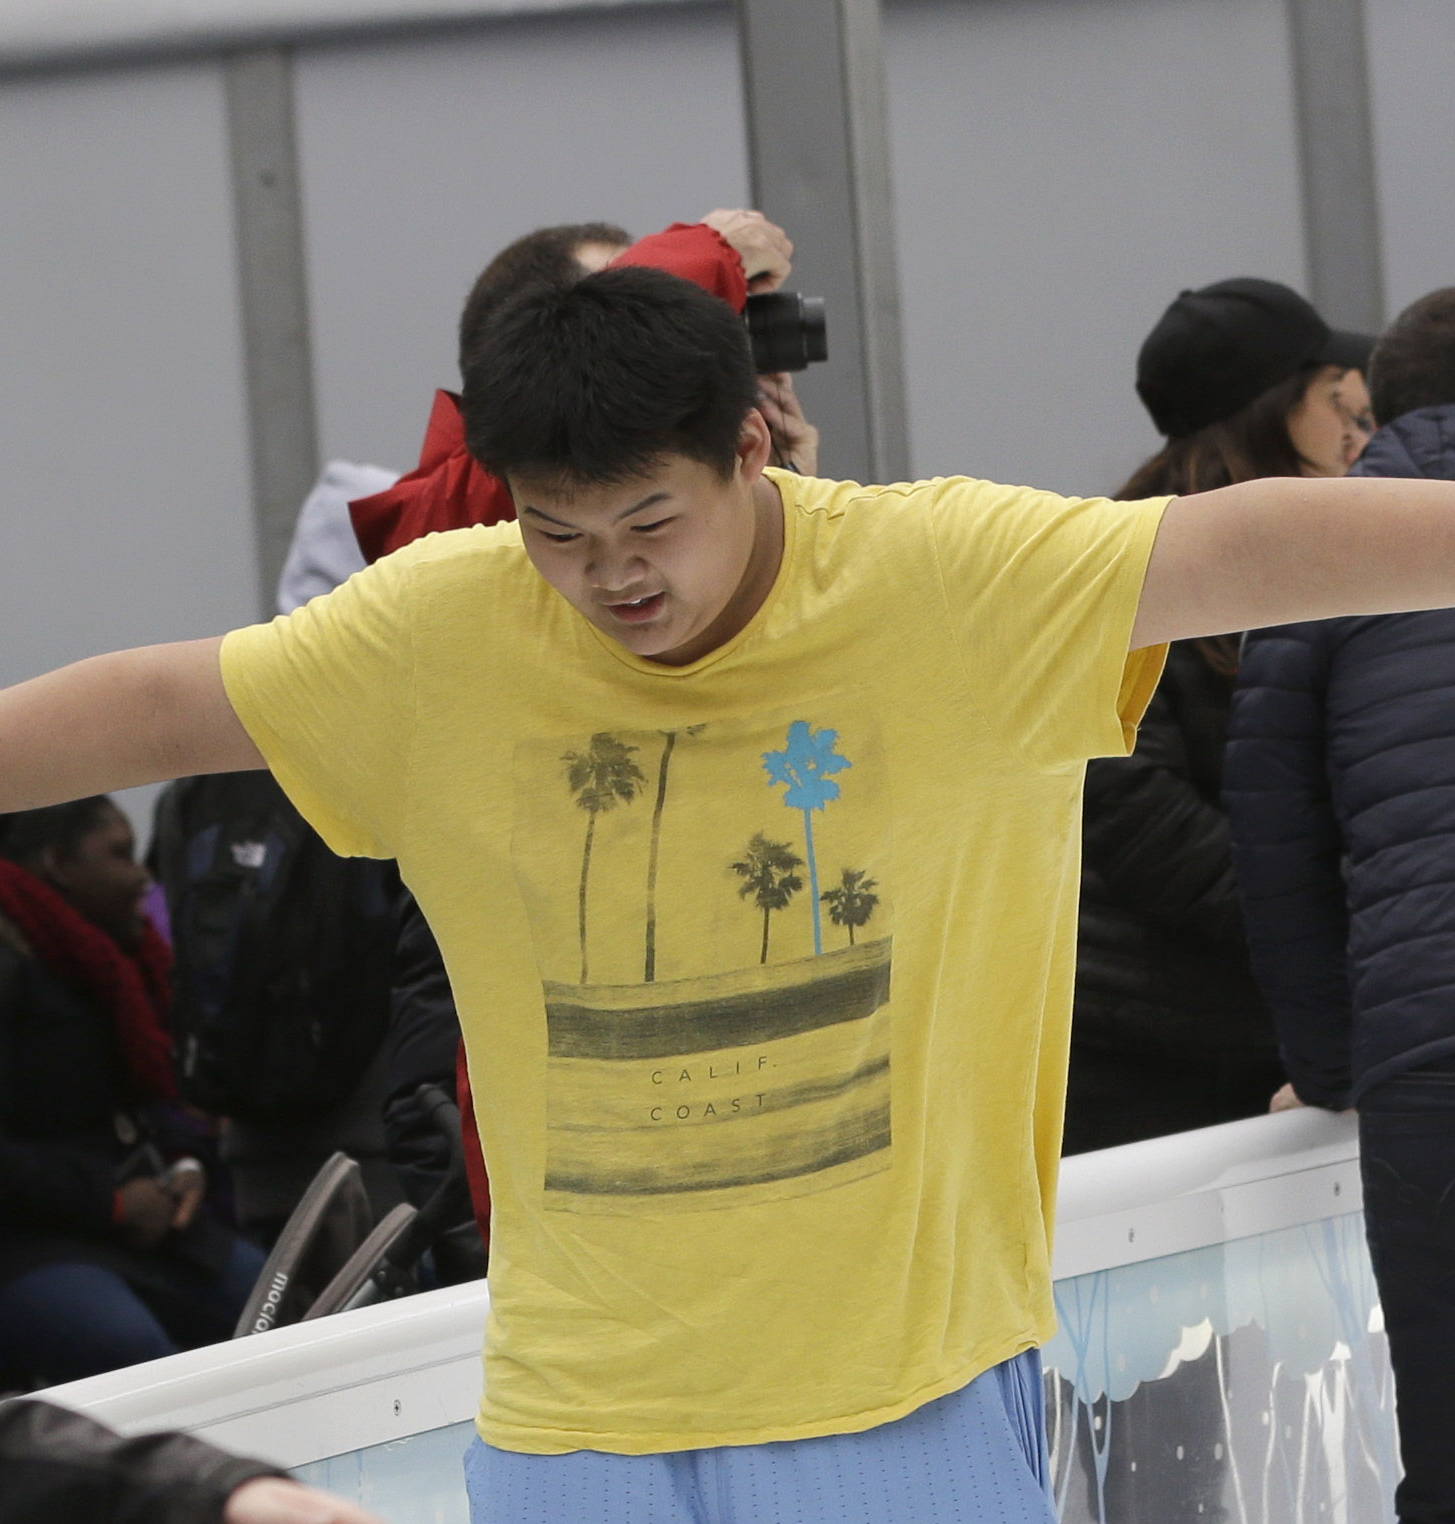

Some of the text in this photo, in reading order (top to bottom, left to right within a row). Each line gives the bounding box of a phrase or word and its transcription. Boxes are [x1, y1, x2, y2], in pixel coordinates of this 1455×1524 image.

[651, 1056, 777, 1085] CALIF.
[650, 1093, 765, 1121] COAST
[252, 1271, 288, 1334] macla
